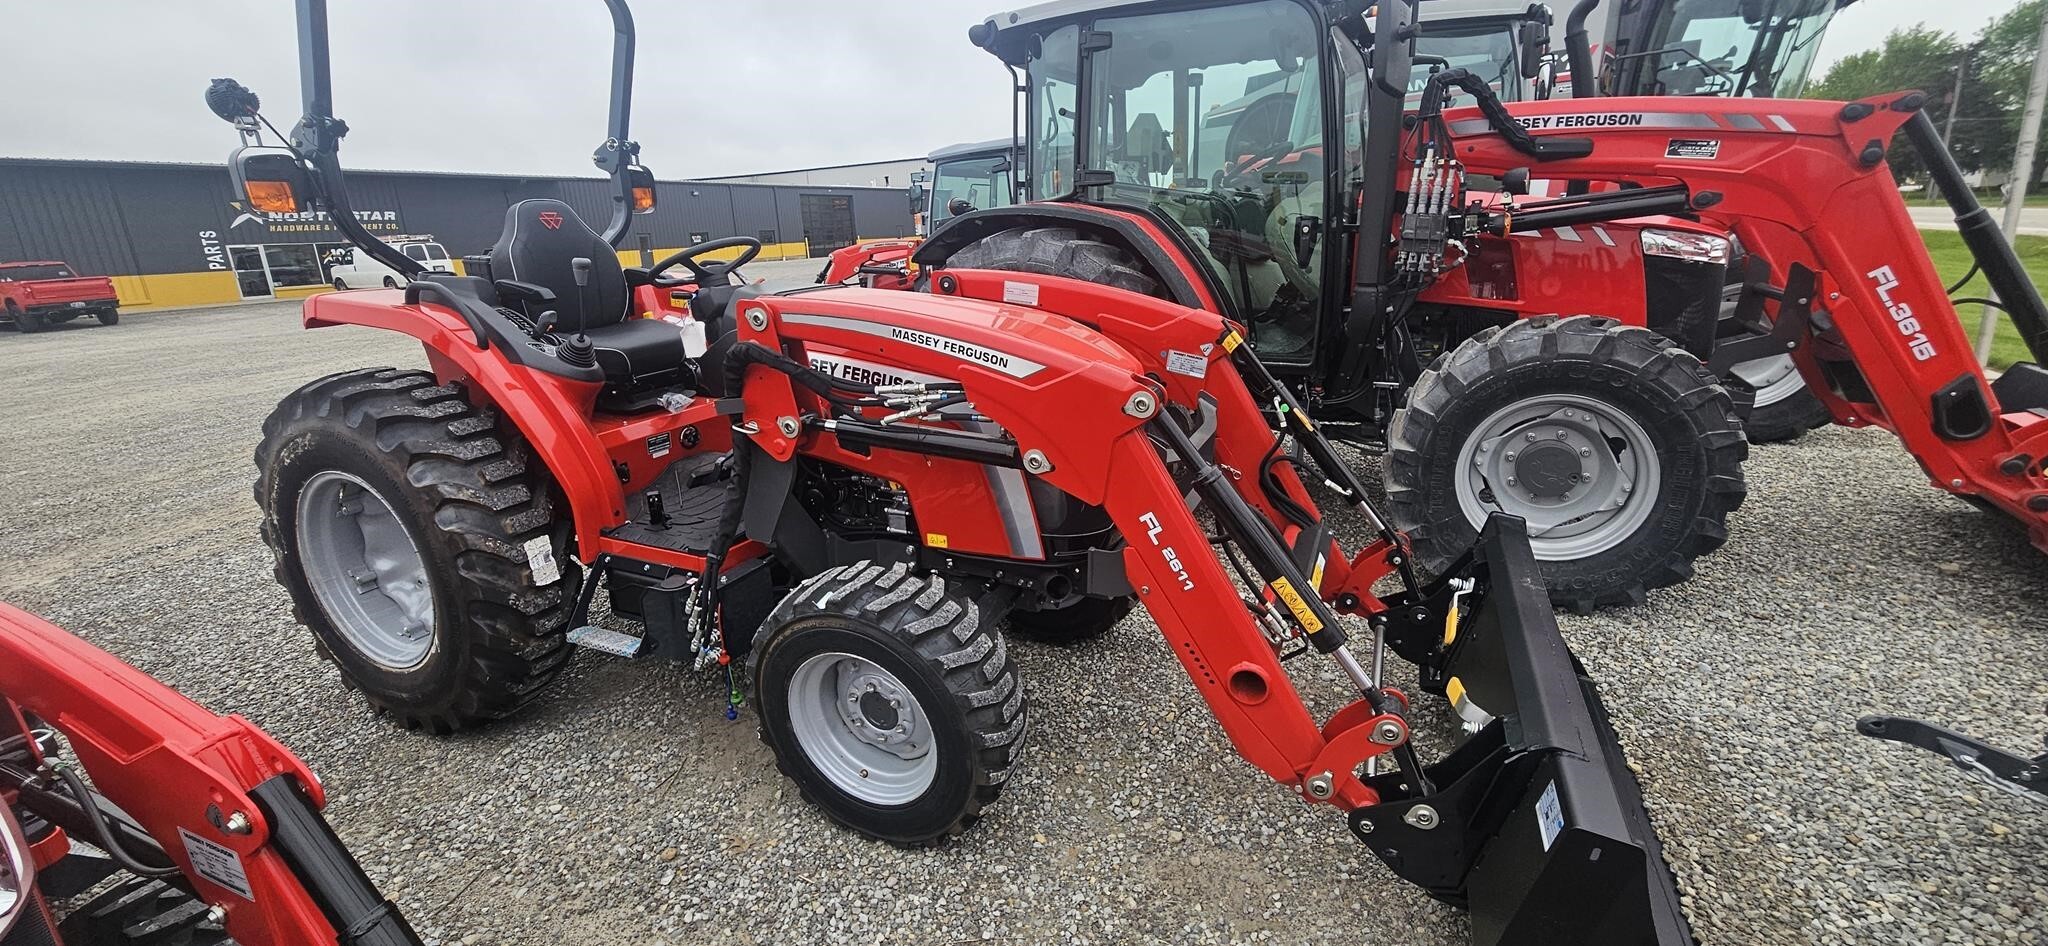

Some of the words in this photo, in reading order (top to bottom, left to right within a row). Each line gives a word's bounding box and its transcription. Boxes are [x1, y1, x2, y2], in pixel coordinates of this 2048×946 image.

[1555, 114, 1642, 128] FERGUSON
[268, 211, 332, 222] NORT
[269, 224, 321, 232] HARDWARE
[199, 230, 227, 270] PARTS
[892, 328, 940, 348] MASSEY
[943, 341, 1009, 369] FERGUSON
[1139, 511, 1163, 546] FL
[1161, 546, 1195, 591] 2611
